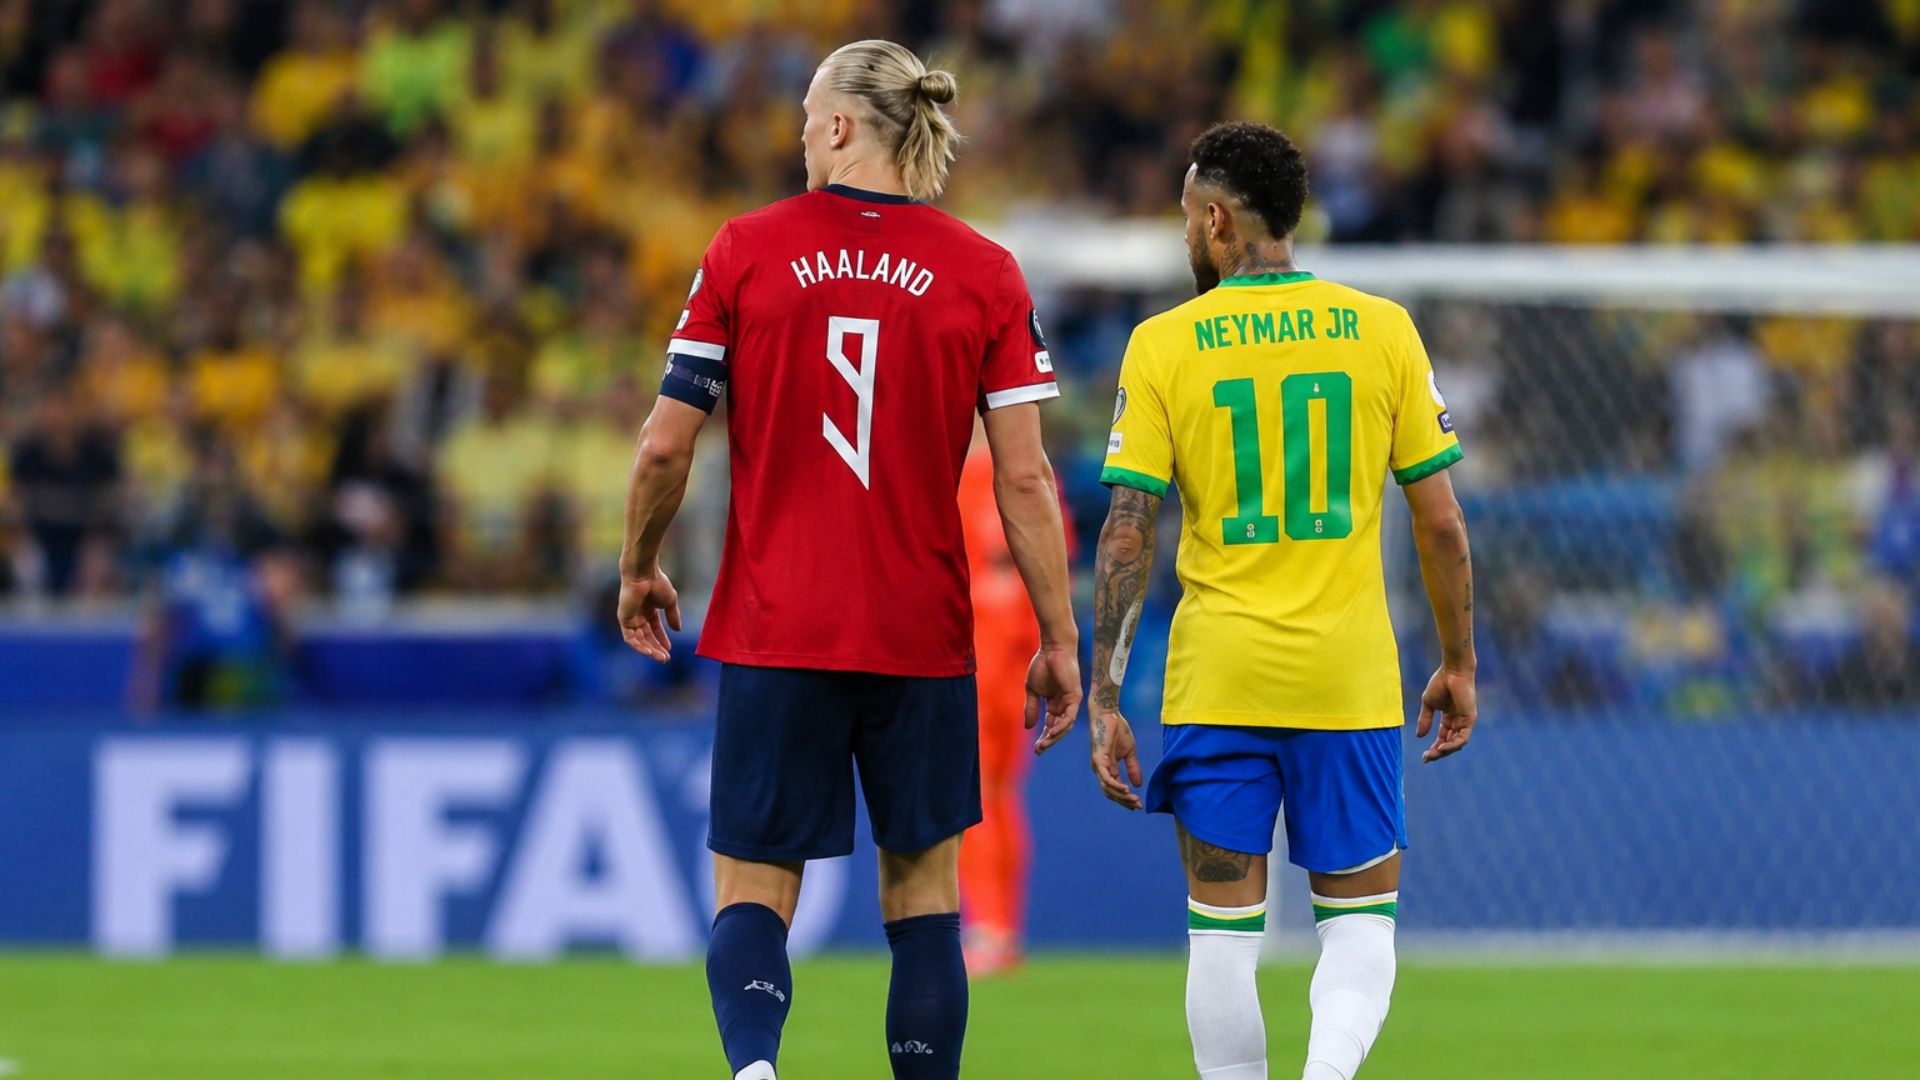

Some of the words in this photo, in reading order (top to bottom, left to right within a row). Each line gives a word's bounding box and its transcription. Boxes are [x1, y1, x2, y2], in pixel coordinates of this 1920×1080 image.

[790, 249, 934, 296] HAALAND
[1194, 308, 1316, 351] NEYMAR
[1326, 307, 1360, 340] JR
[823, 316, 880, 490] 9
[1212, 371, 1353, 545] 10
[92, 738, 701, 961] FIFA
